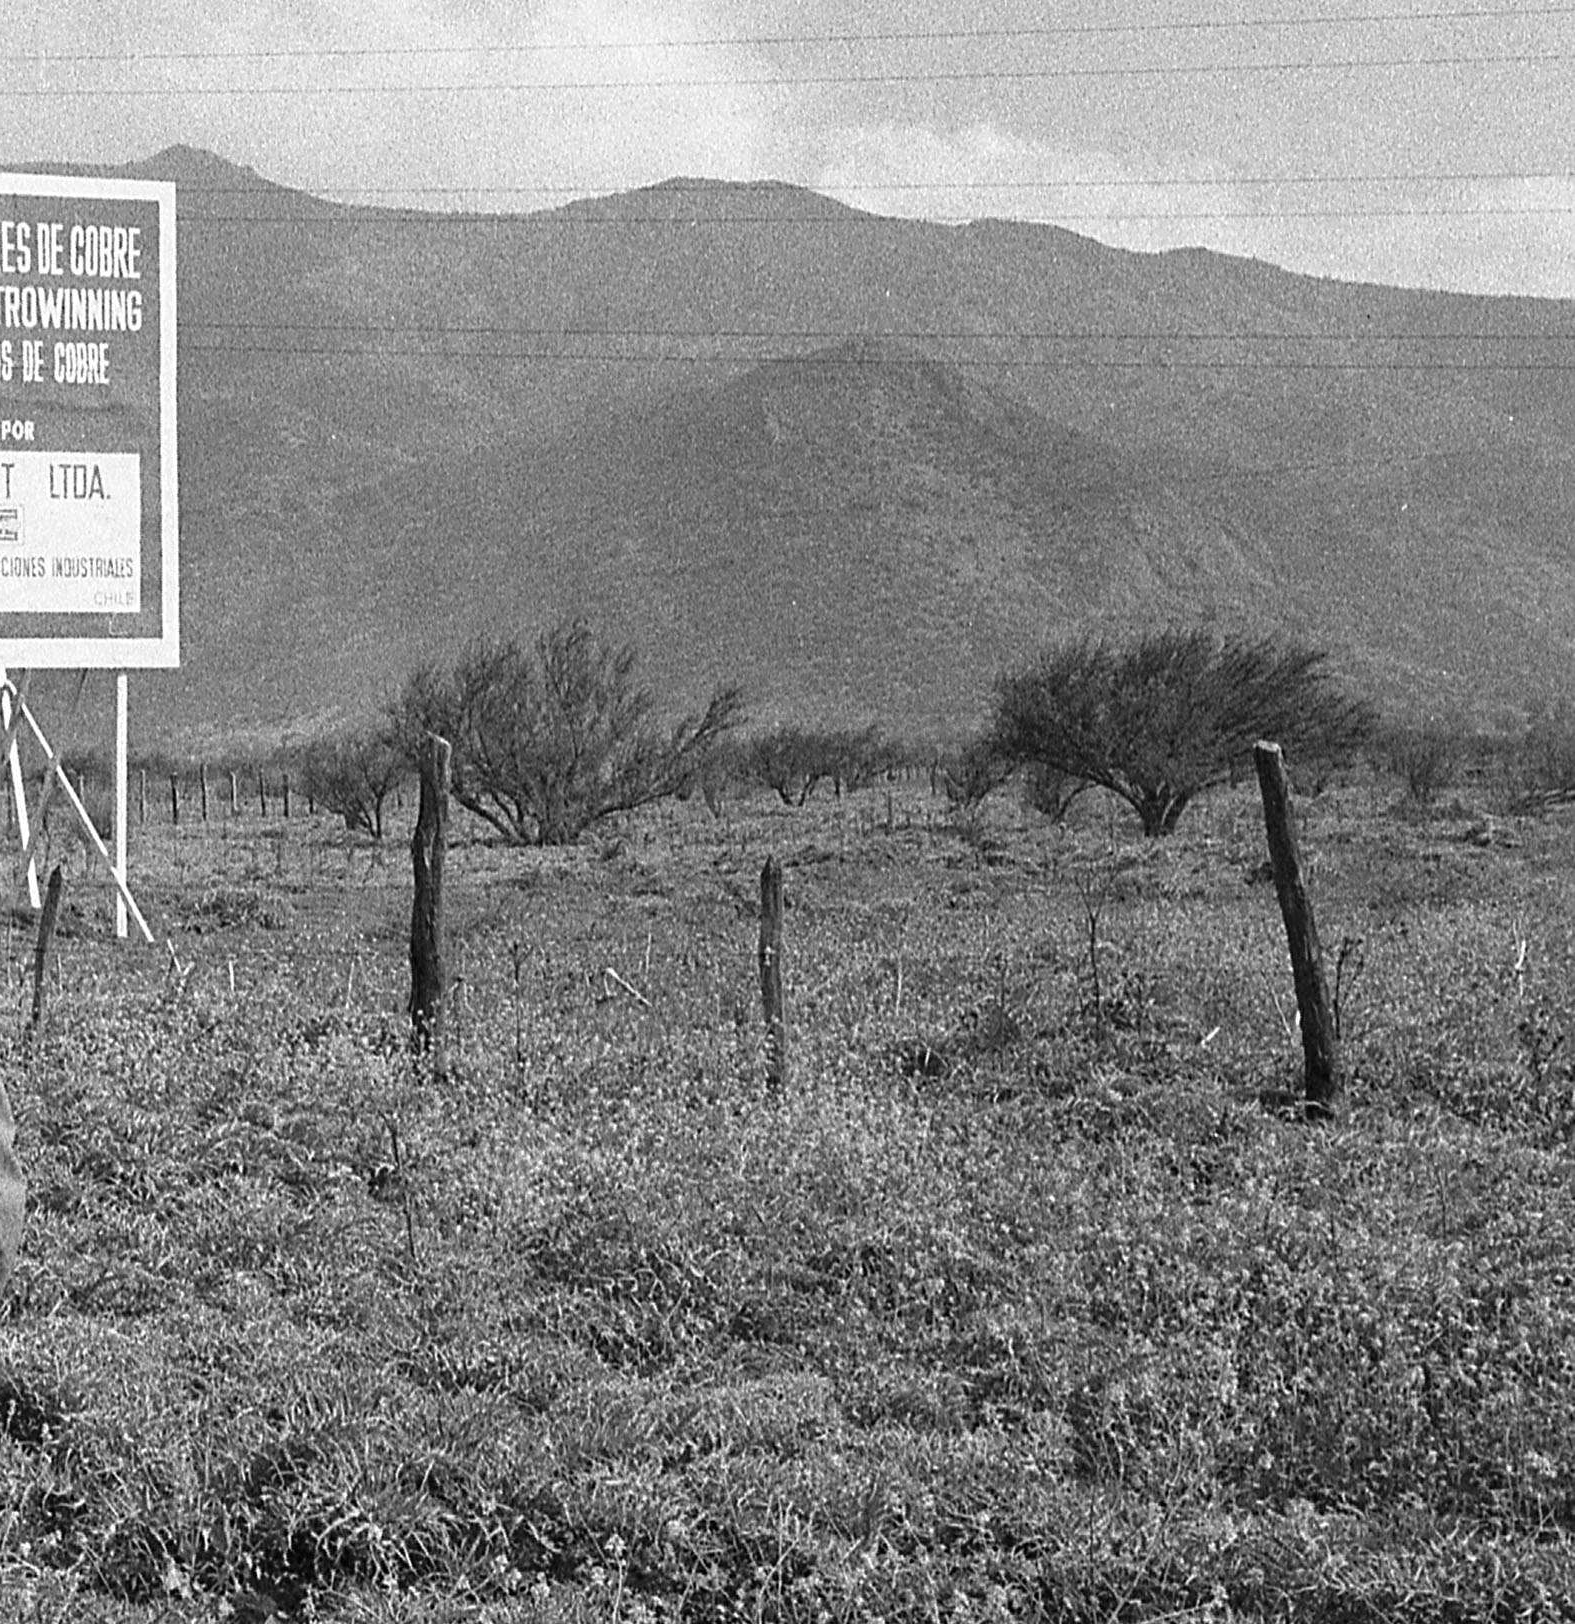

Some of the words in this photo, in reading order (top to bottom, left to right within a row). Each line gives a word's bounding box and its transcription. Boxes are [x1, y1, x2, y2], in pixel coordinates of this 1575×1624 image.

[37, 223, 64, 276] DE
[70, 225, 141, 279] COBRE
[22, 340, 44, 382] DE
[54, 342, 109, 384] COBRE
[1, 419, 35, 441] POR
[50, 463, 112, 500] LTDA.
[51, 557, 134, 579] INDUSTRIALES
